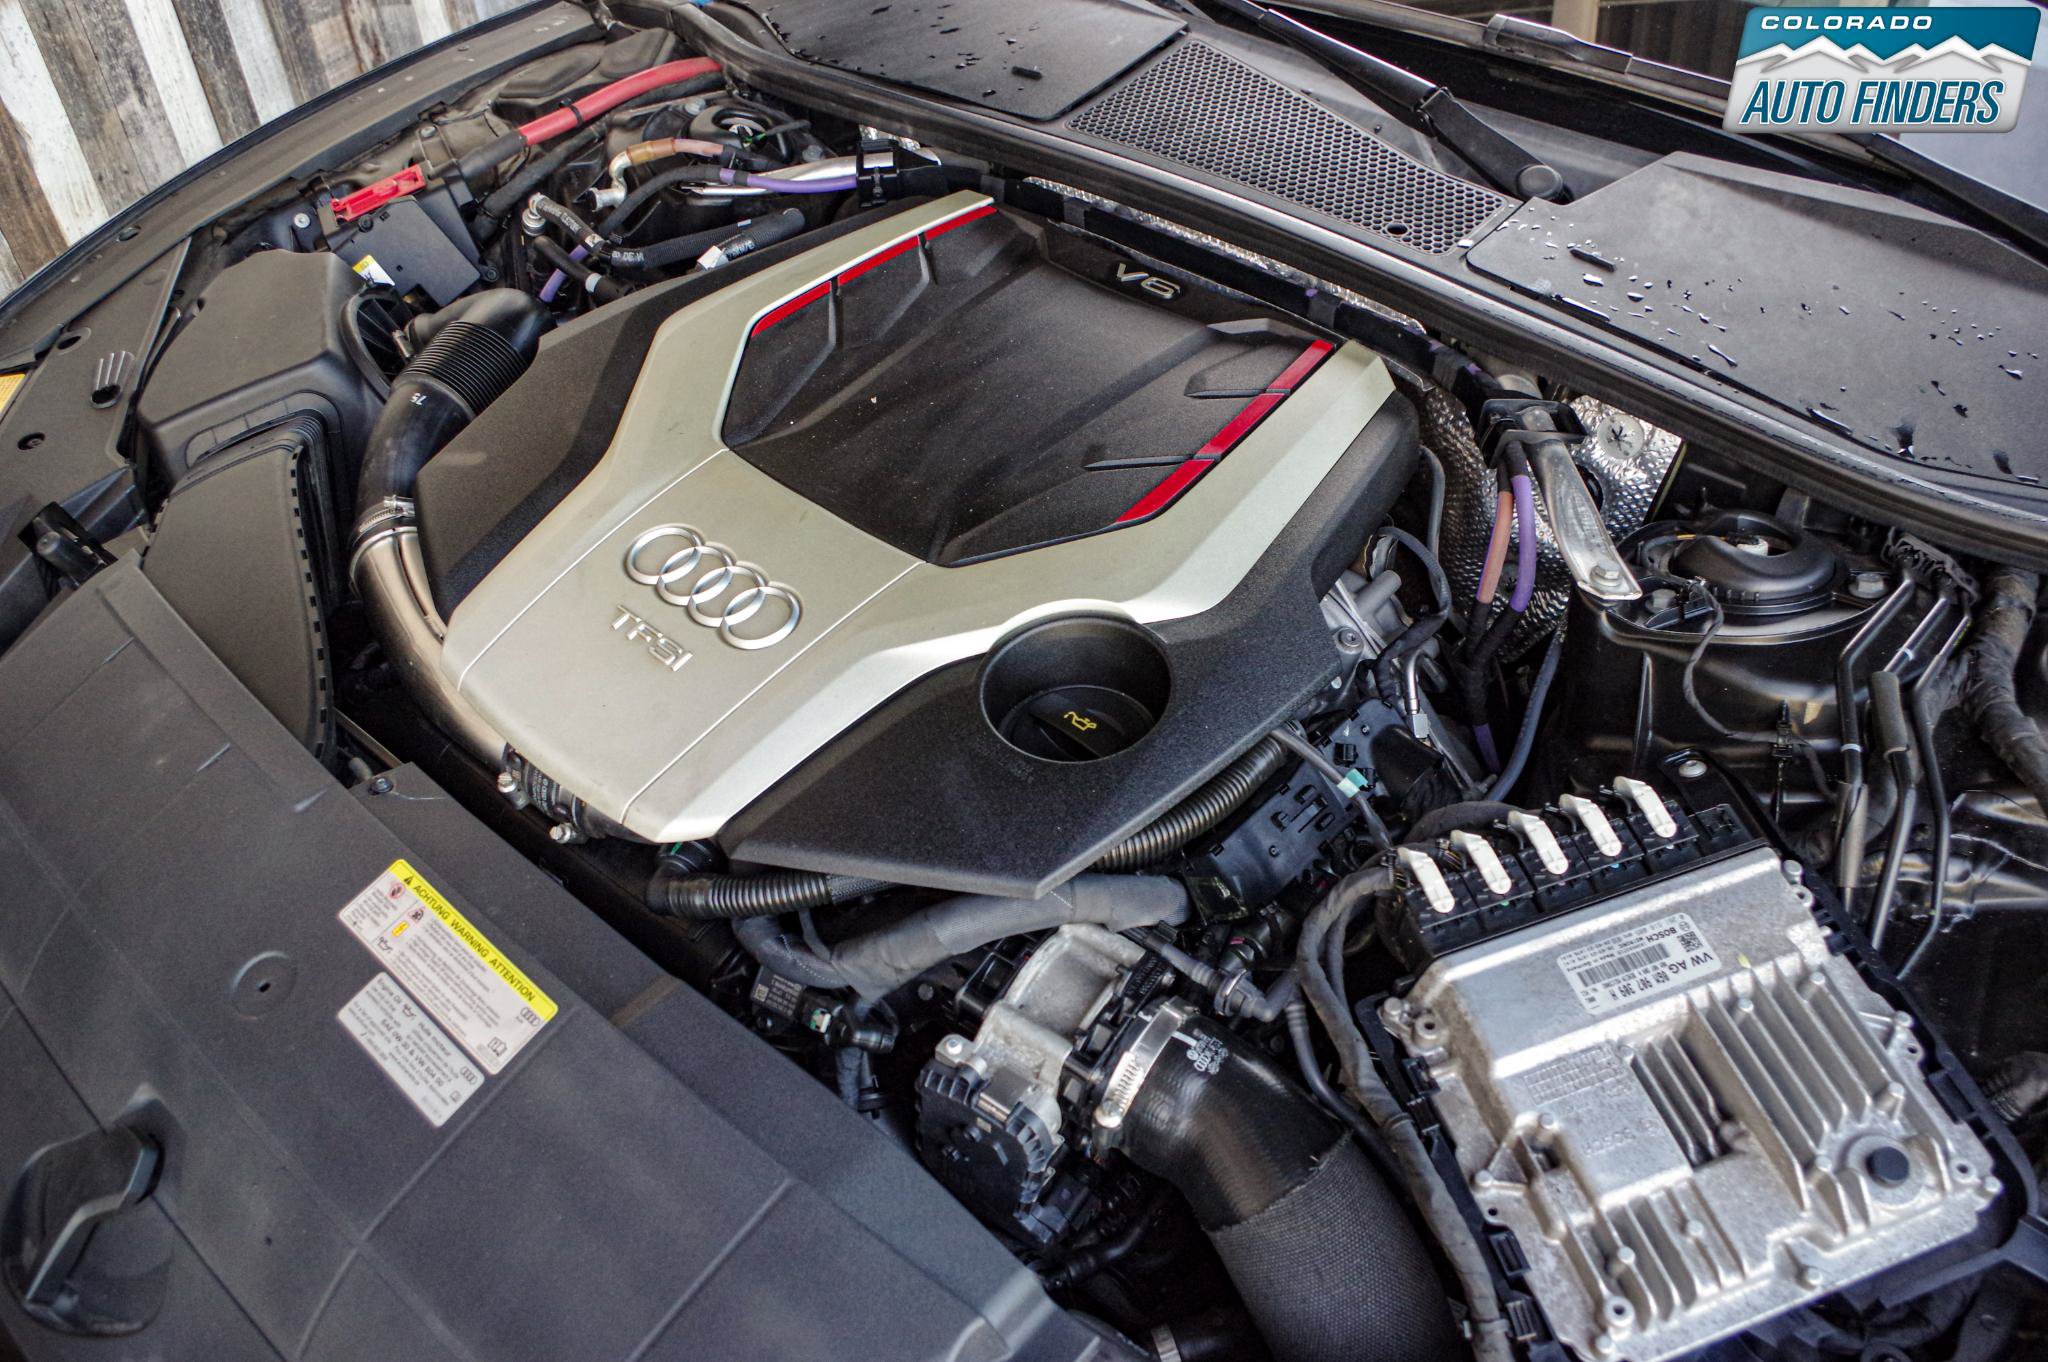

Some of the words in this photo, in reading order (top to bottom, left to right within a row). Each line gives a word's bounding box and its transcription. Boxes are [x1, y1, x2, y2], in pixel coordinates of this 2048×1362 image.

[1117, 262, 1181, 300] V6
[610, 604, 693, 672] TFSI
[413, 884, 449, 920] ACHTUNG
[450, 919, 489, 958] WARNING
[489, 958, 536, 1002] ATTENTION
[1645, 926, 1677, 943] BOSCH
[1665, 960, 1691, 975] AG
[1691, 951, 1714, 968] VW
